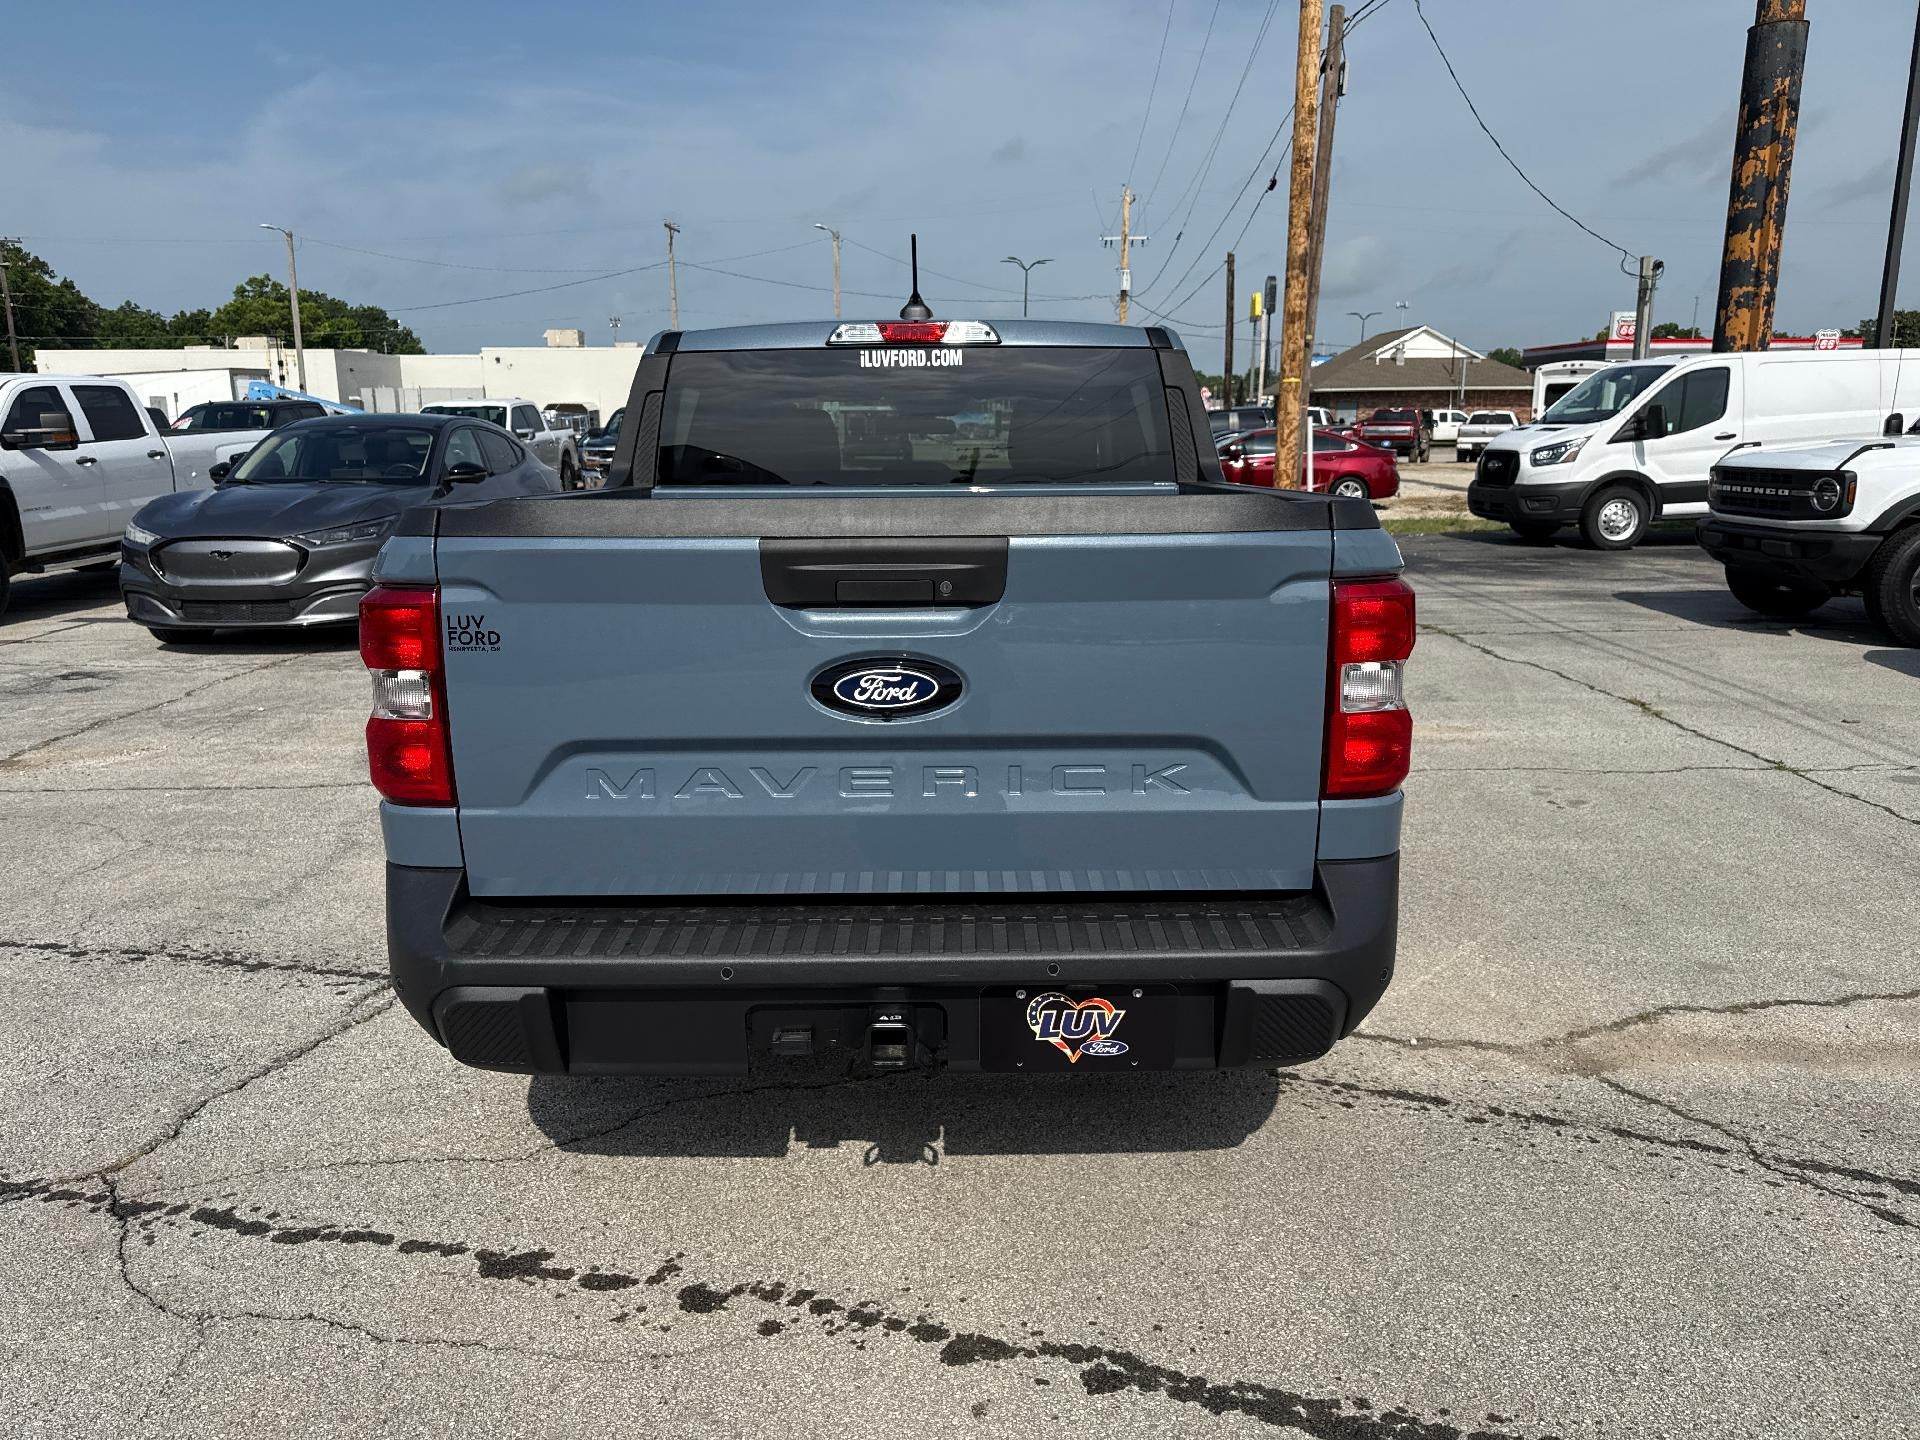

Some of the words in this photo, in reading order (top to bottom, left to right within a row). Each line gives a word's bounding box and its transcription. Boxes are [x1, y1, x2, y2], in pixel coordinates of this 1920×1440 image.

[1619, 325, 1636, 336] 66
[1819, 339, 1836, 350] 66
[860, 349, 963, 368] iLUVFORD.COM
[1722, 485, 1790, 496] BRONCO
[447, 615, 485, 630] LUV
[448, 631, 501, 645] FORD
[853, 674, 919, 701] Ford
[585, 763, 1191, 799] MAVERICK
[1035, 1010, 1126, 1040] LUV
